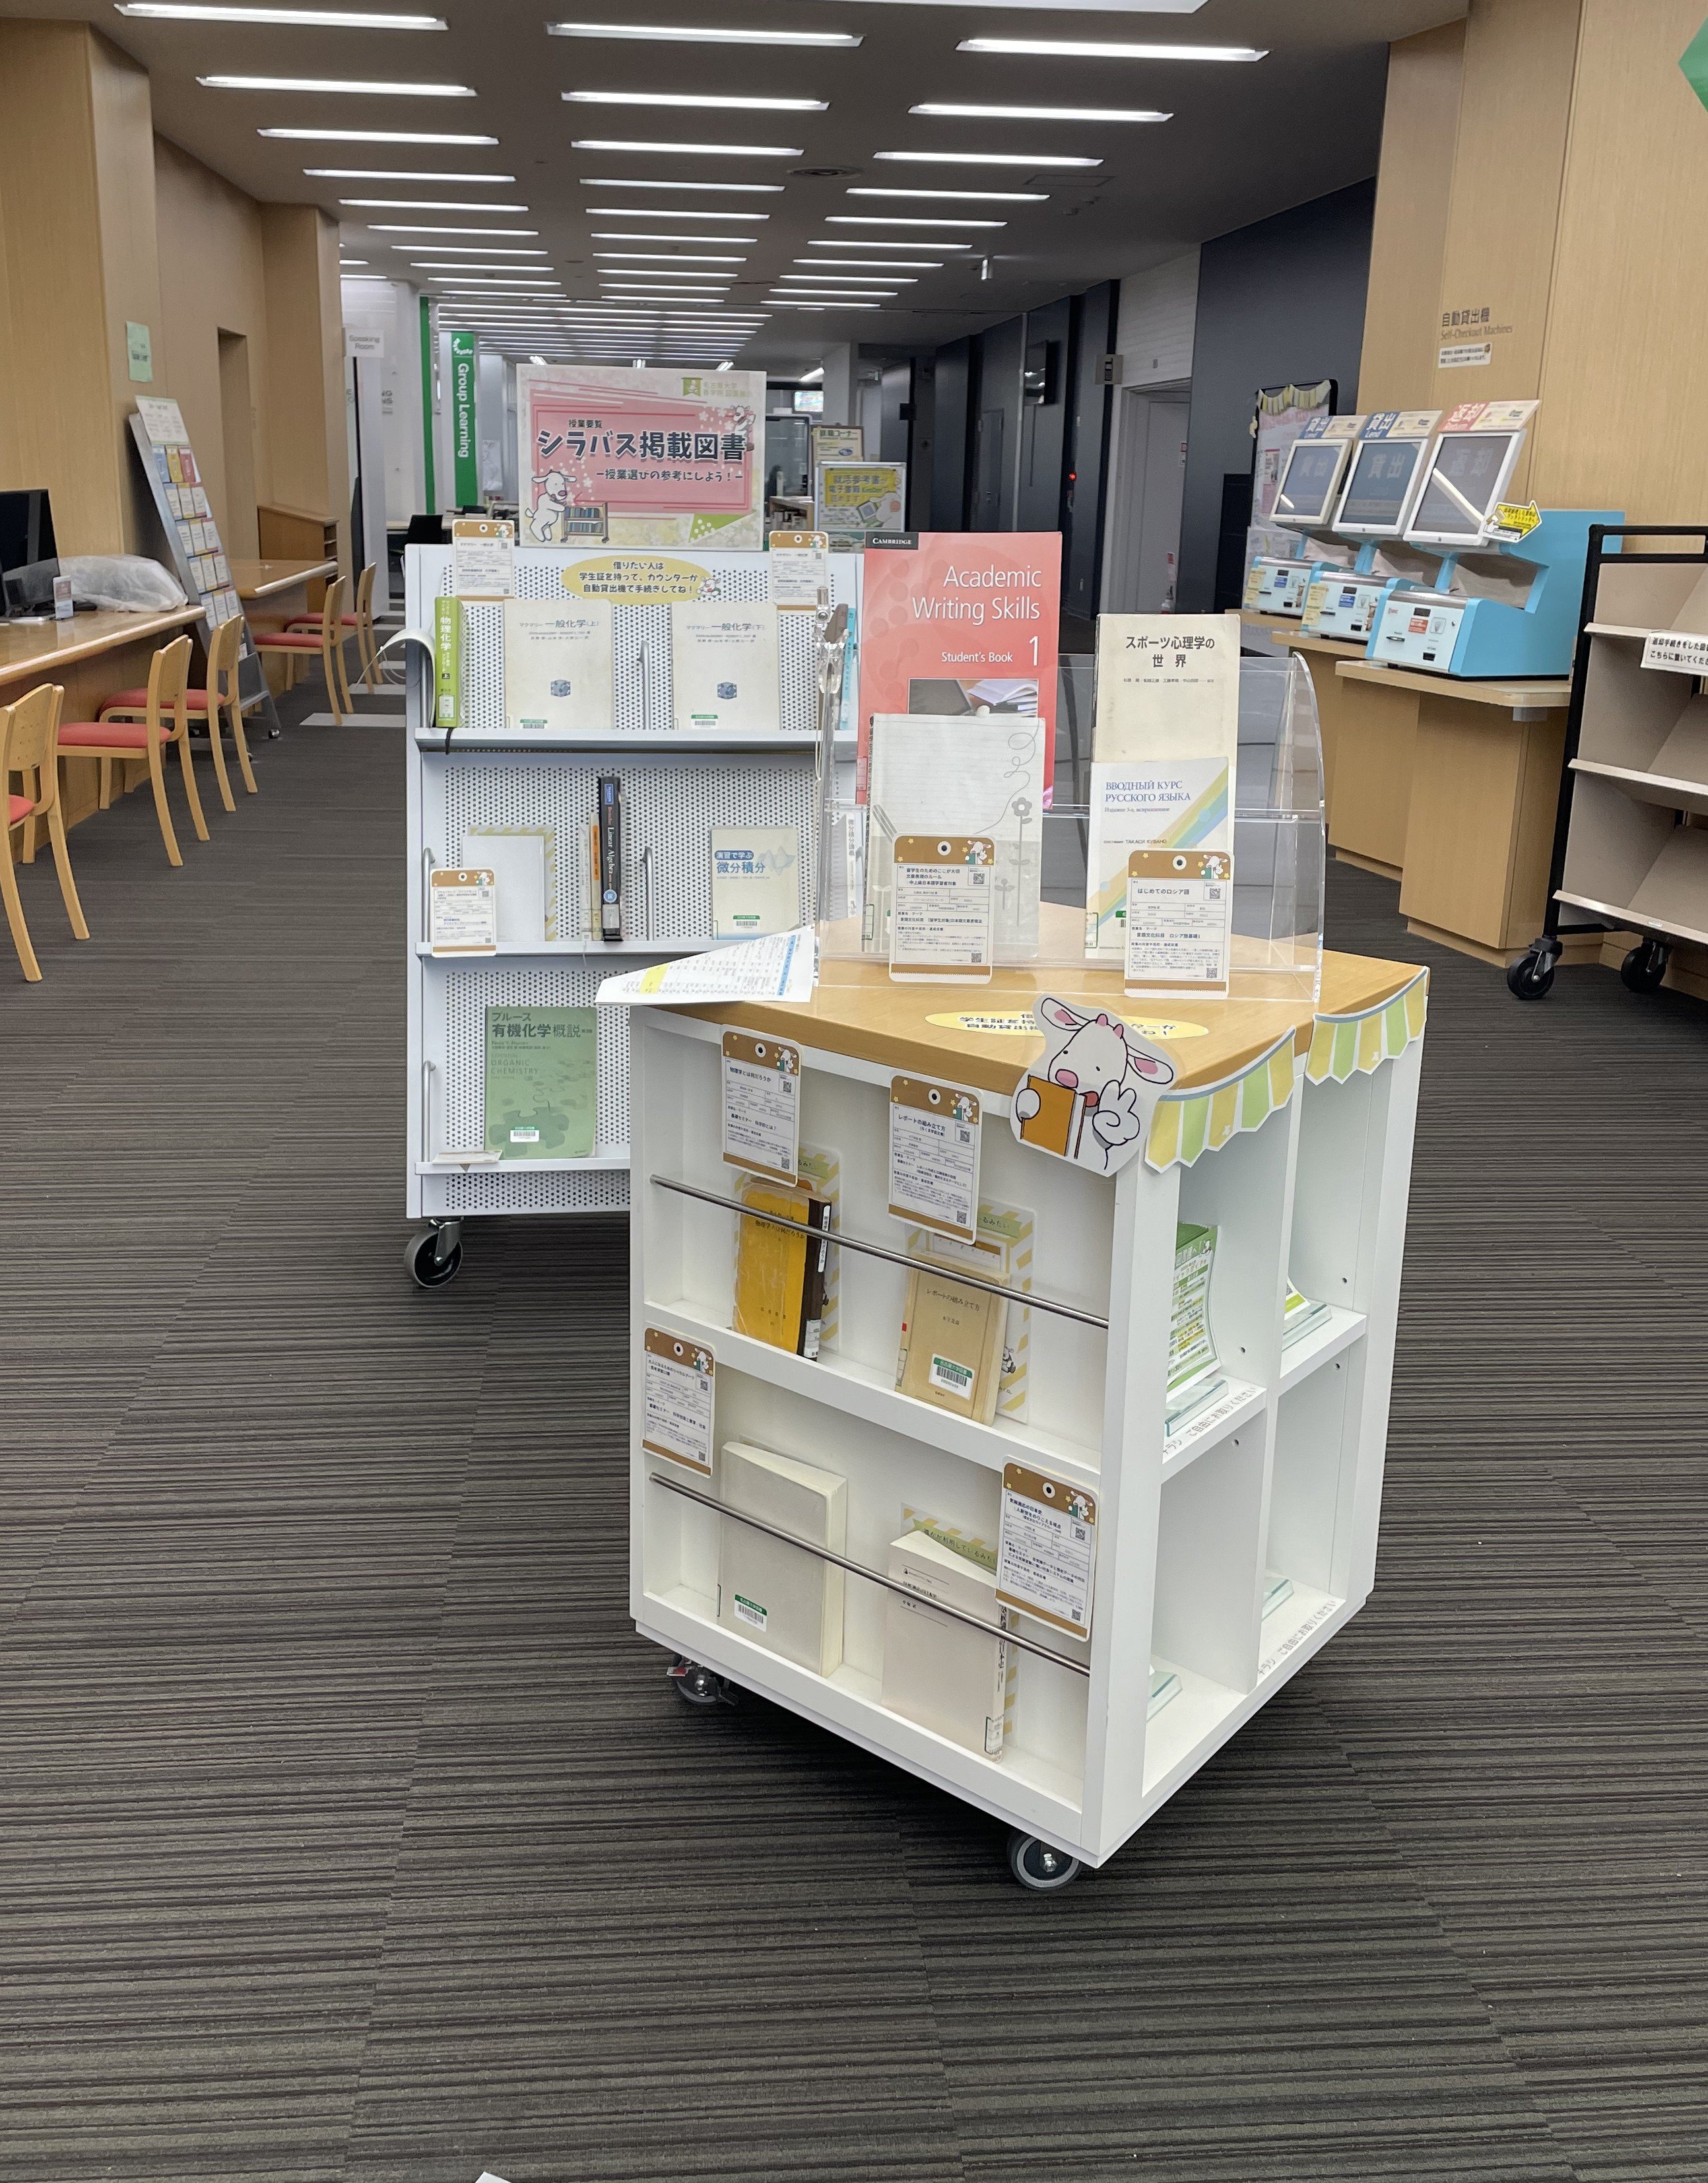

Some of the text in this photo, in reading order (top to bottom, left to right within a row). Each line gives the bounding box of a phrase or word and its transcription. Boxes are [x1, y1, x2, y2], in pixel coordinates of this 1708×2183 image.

[1442, 307, 1490, 327] 自動貸出機
[457, 363, 470, 402] Group
[1366, 412, 1397, 430] 貸出
[1447, 403, 1486, 422] 返却
[458, 403, 471, 459] Learning
[568, 419, 603, 429] 授業要覧
[1305, 417, 1330, 431] 貸出
[537, 430, 747, 461] シラバス掲載図書
[613, 560, 665, 570] 借りたい人は
[943, 564, 1042, 588] Academic
[583, 583, 694, 595] 自動貸出機で手続きしてね！
[912, 595, 1041, 626] Writing Skills
[440, 616, 451, 652] 物理化学
[1125, 635, 1216, 650] スポーツ心理学の
[941, 635, 1039, 667] Student's Book 1
[1105, 780, 1183, 791] ВВОДНЫЙ КУРС
[1105, 792, 1191, 803] РУССКОГО ЯЗЫКА
[607, 849, 616, 875] Algebra
[716, 851, 753, 859] 演習で学ぶ
[716, 861, 766, 874] 微分積分
[492, 1012, 532, 1022] ブルース
[492, 1023, 581, 1038] 有機化学概説
[898, 1114, 946, 1132] レポートの組み立て方
[926, 1288, 981, 1312] レポートの組み立て方
[1186, 1387, 1257, 1438] ご自由にお取りください
[1277, 1599, 1337, 1656] ご自由にお取りください
